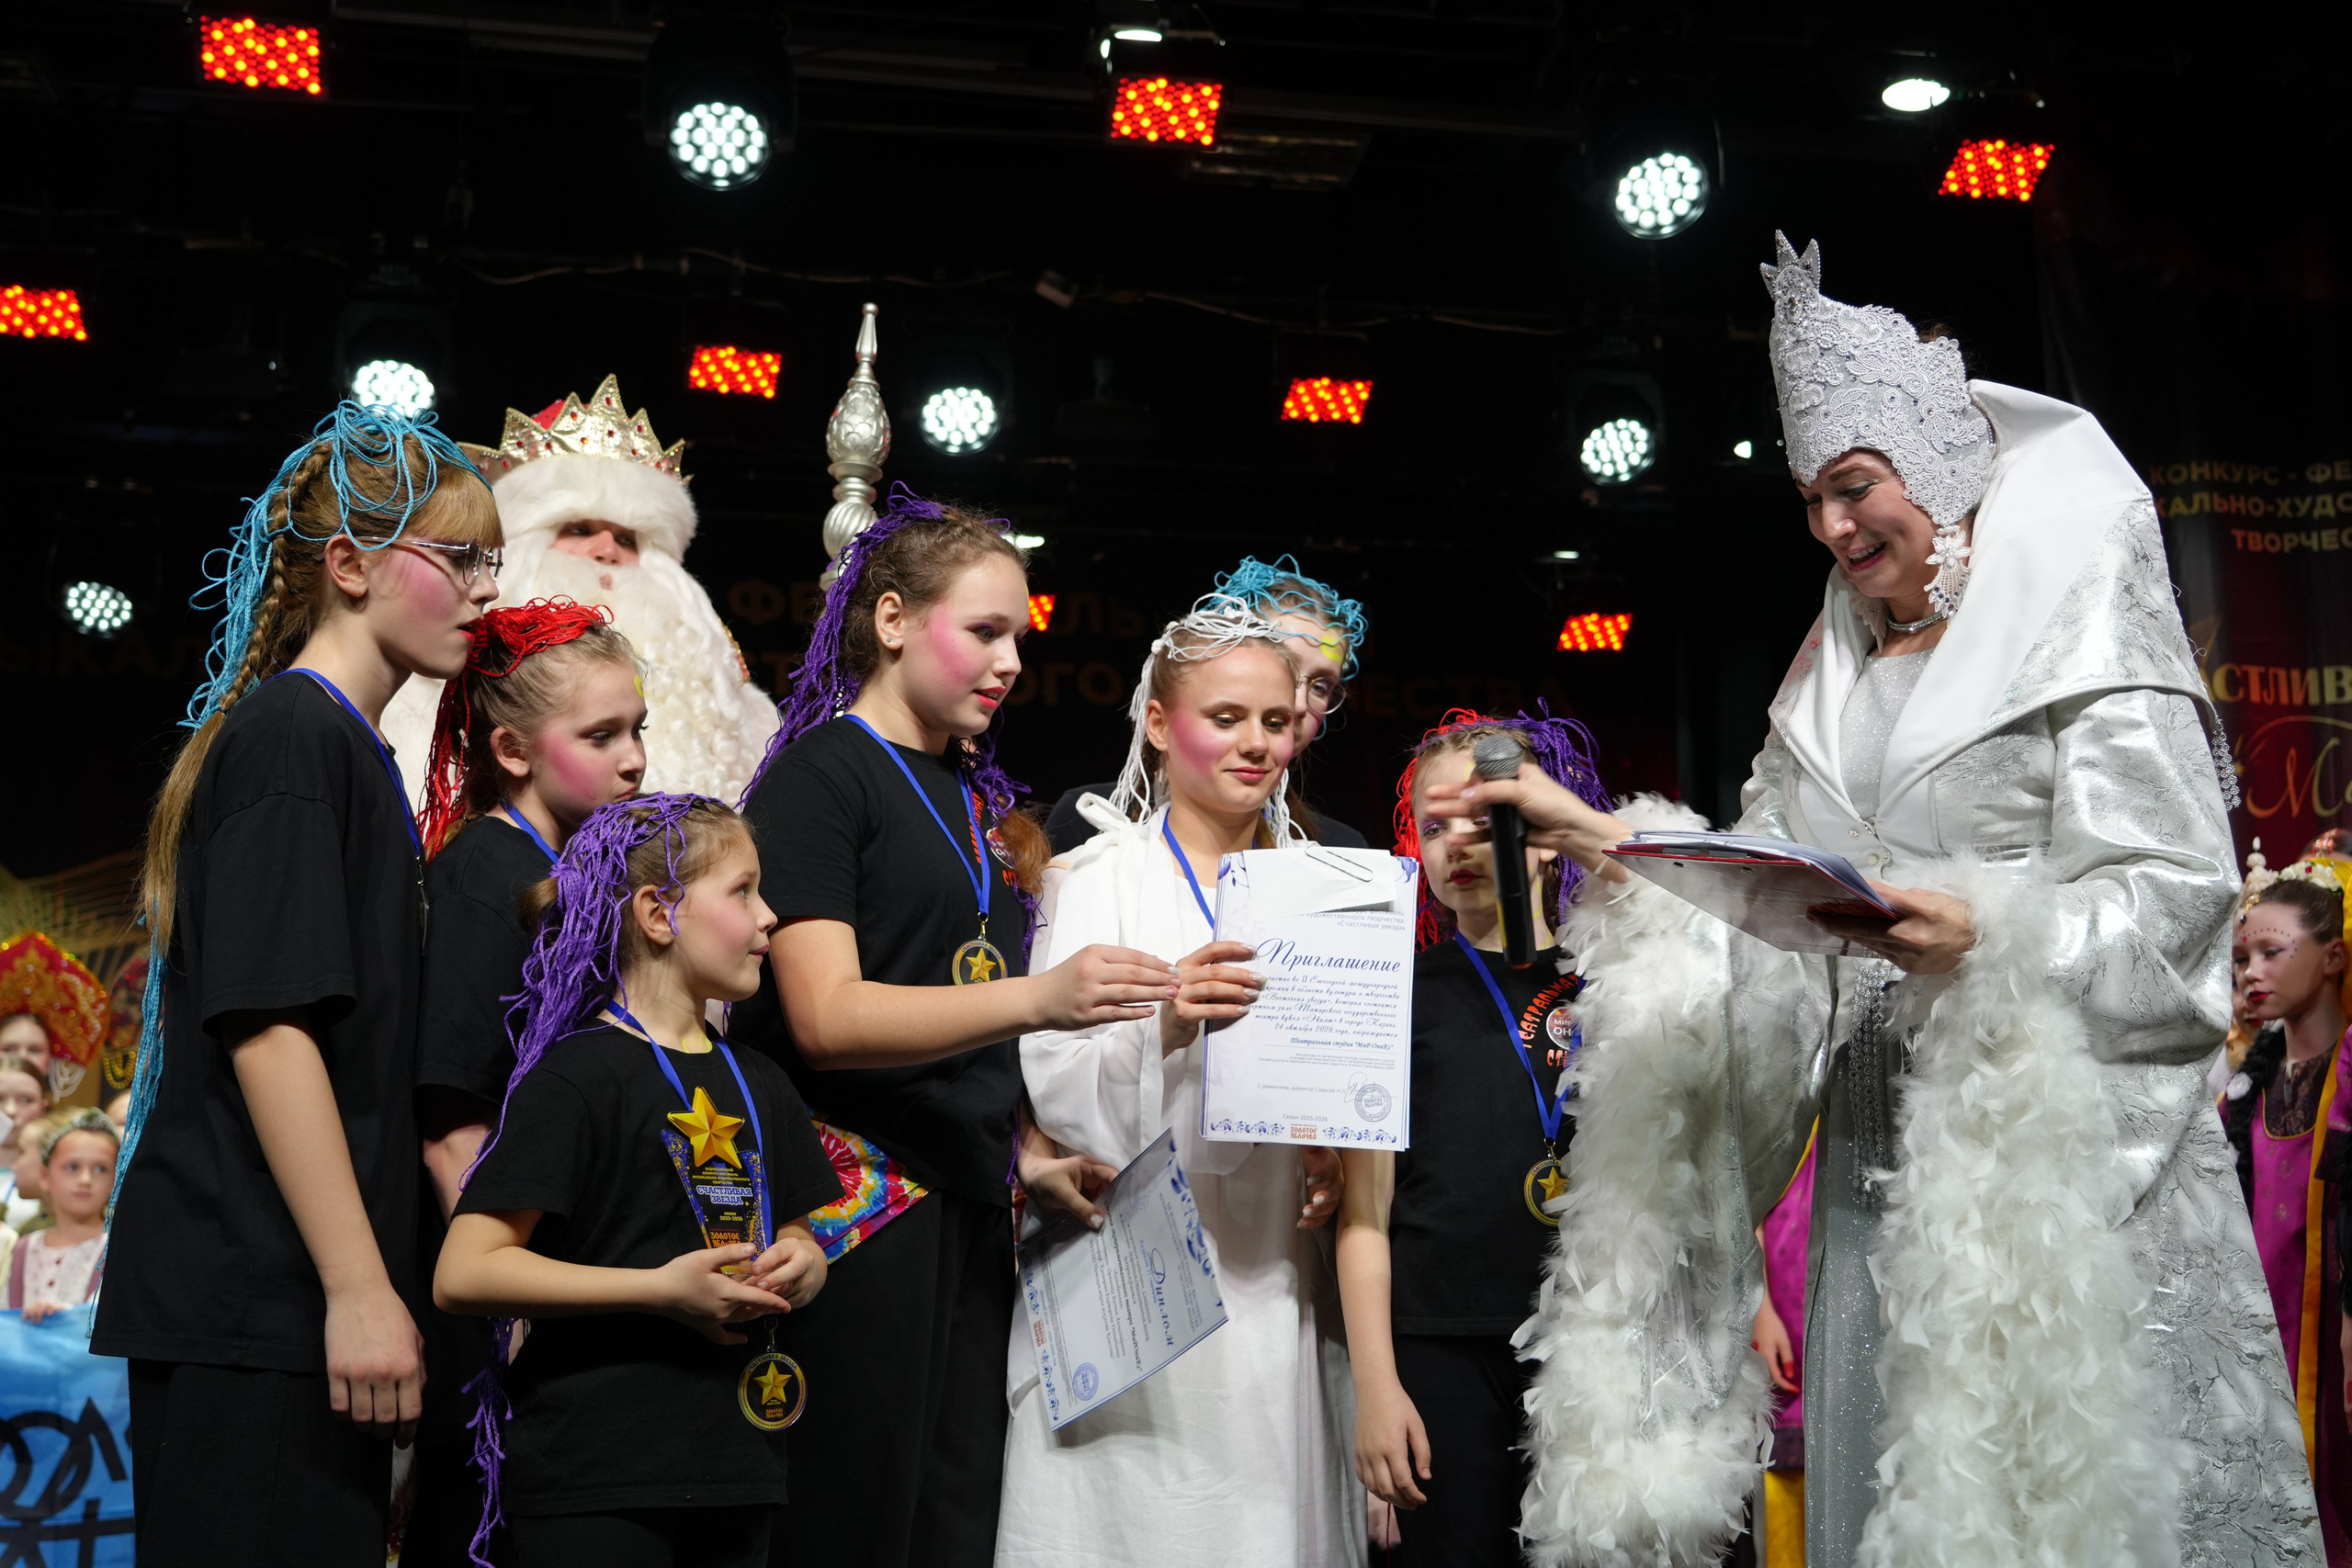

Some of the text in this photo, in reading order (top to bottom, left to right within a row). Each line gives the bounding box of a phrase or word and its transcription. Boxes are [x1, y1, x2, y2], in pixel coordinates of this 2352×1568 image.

[2149, 460, 2279, 486] КОНКУРС
[1255, 938, 1401, 973] Приглашение
[1365, 1018, 1396, 1028] Казань
[1315, 1025, 1334, 1033] 2026
[1290, 1037, 1331, 1045] Театральная
[1332, 1040, 1353, 1048] студия
[1300, 1114, 1329, 1122] 2025-2026
[696, 1185, 752, 1197] СЧАСТЛИВАЯ
[710, 1194, 743, 1205] ЗВЕЗДА
[709, 1231, 741, 1240] ЗОЛОТОЕ
[1148, 1247, 1175, 1348] Диплом
